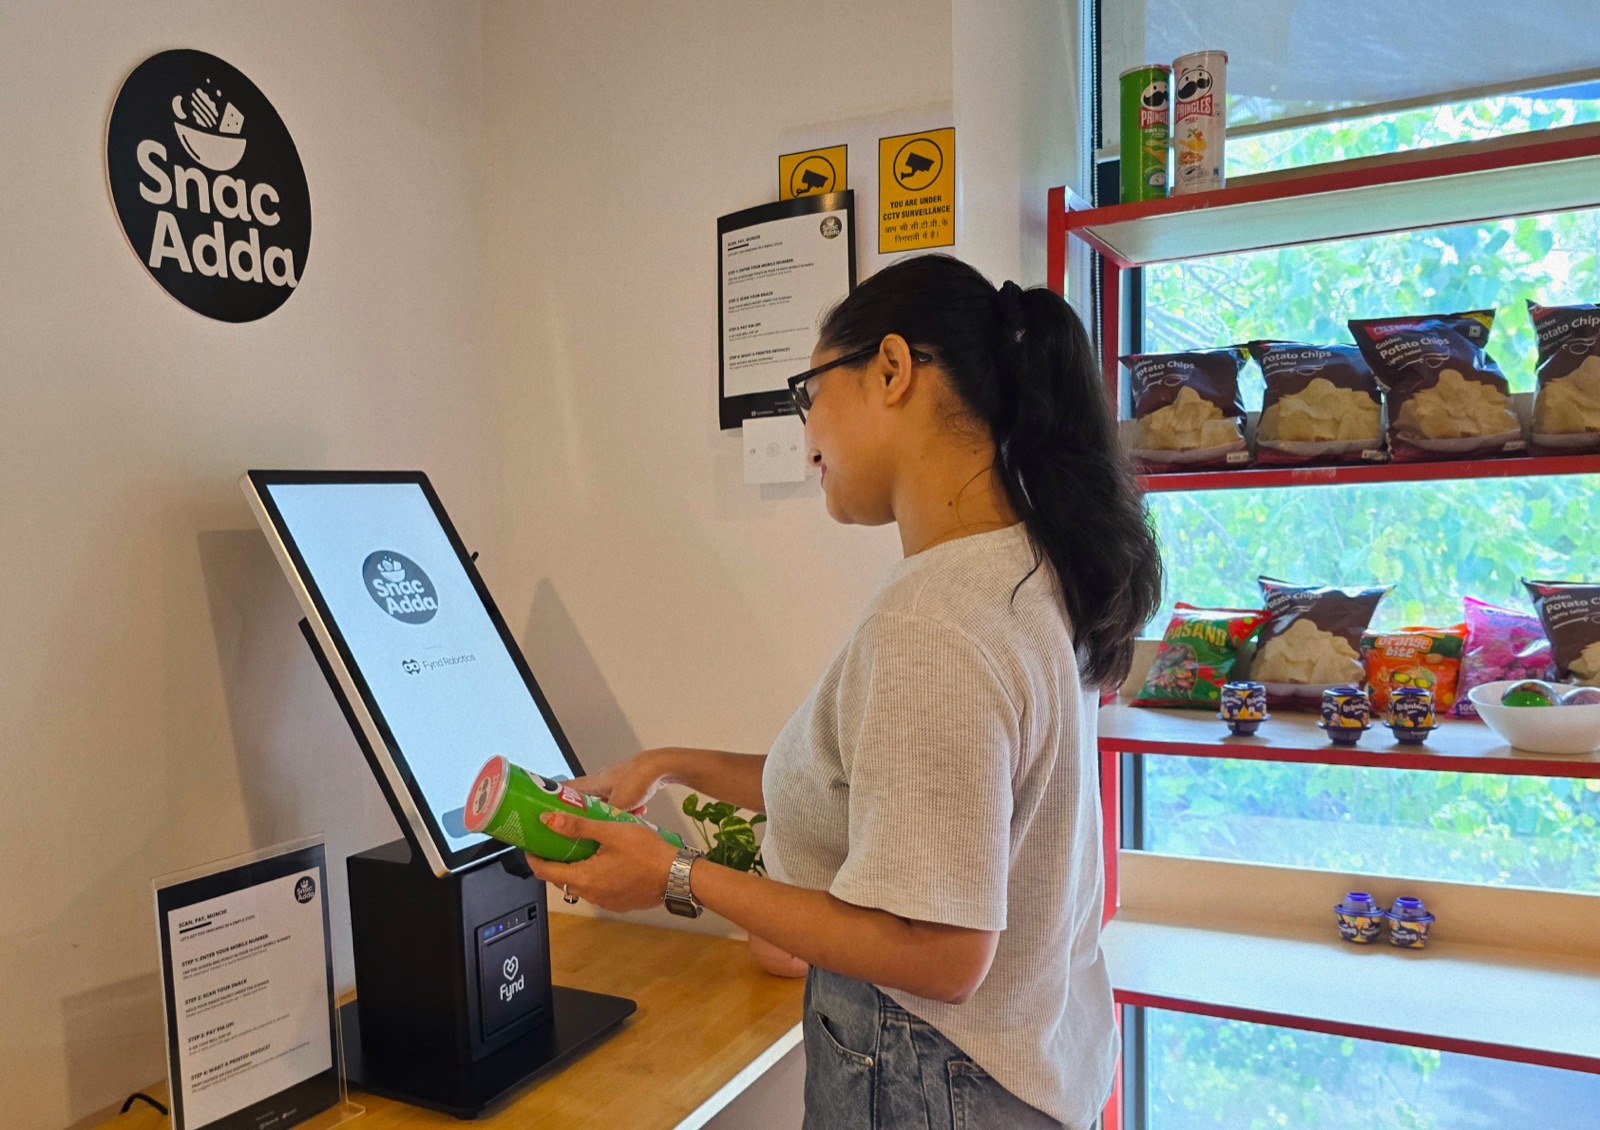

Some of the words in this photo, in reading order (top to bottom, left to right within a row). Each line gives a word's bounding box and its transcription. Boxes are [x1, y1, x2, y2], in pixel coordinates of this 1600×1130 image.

[1176, 97, 1211, 119] PRINGLES
[136, 139, 281, 226] Snac
[890, 201, 903, 209] YOU
[905, 198, 917, 207] ARE
[920, 195, 942, 205] UNDER
[883, 211, 900, 221] CCTV
[902, 205, 950, 218] SURVEILLANCE
[822, 224, 839, 232] Snac
[823, 229, 840, 237] Adda
[149, 210, 298, 288] Adda
[1375, 336, 1402, 350] Golden
[1379, 340, 1419, 359] Potato
[1420, 337, 1450, 347] Chips
[1301, 350, 1332, 359] Chips
[1167, 360, 1195, 369] Chips
[373, 578, 425, 597] Snac
[1293, 591, 1322, 600] Chips
[386, 594, 438, 615] Adda
[1545, 600, 1588, 614] Potato
[1377, 635, 1430, 650] orange
[1385, 646, 1415, 658] bite
[422, 658, 444, 671] Fynd
[444, 654, 476, 666] Robotics
[296, 886, 313, 895] Snac
[297, 891, 315, 901] Adda
[178, 918, 194, 928] SCAN,
[194, 915, 205, 923] PAY,
[181, 958, 194, 967] STEP
[199, 951, 214, 961] ENTER
[215, 946, 229, 956] YOUR
[230, 940, 247, 951] MOBILE
[248, 933, 268, 944] NUMBER
[184, 996, 197, 1005] STEP
[202, 989, 216, 999] SCAN
[217, 984, 230, 993] YOUR
[231, 978, 247, 988] SNACK
[500, 974, 525, 1002] Fynd
[188, 1034, 200, 1043] STEP
[206, 1028, 215, 1036] PAY
[216, 1024, 225, 1032] VIA
[190, 1071, 202, 1082] STEP
[208, 1062, 223, 1074] WANT
[228, 1052, 248, 1066] PRINTED
